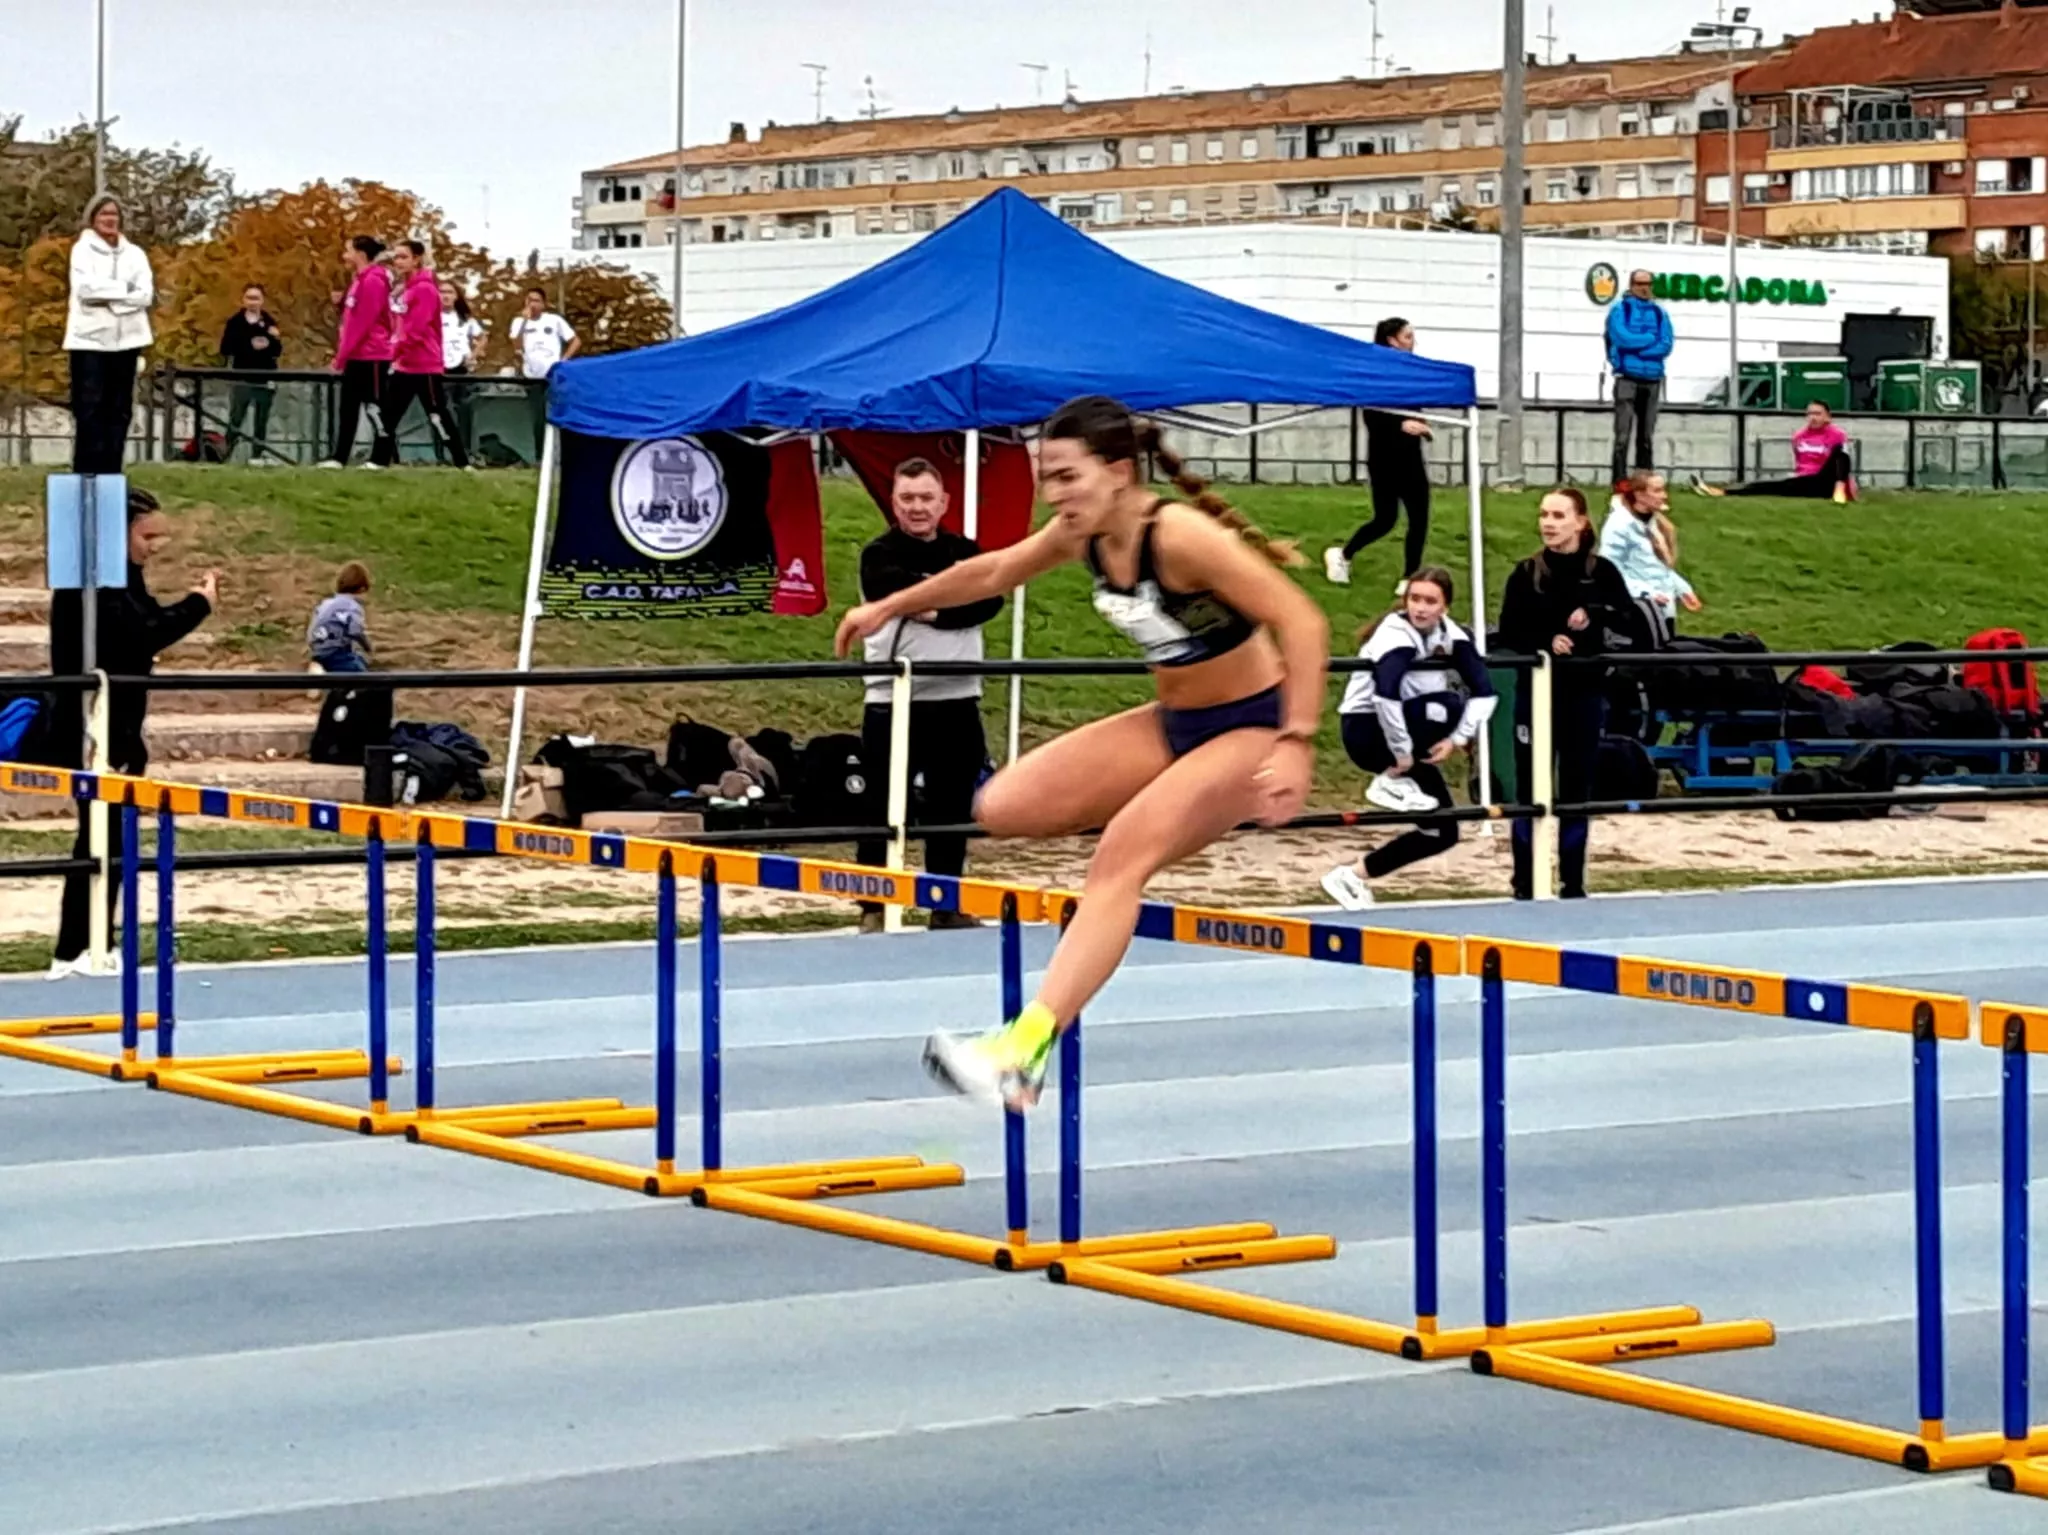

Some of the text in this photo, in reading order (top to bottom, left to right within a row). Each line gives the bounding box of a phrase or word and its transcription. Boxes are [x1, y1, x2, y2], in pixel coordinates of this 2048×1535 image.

[1652, 273, 1827, 305] MERCADONA
[585, 584, 643, 600] C.A.D.
[820, 870, 895, 897] MONDO
[1196, 917, 1284, 949] MONDO
[1647, 968, 1755, 1005] MONDO
